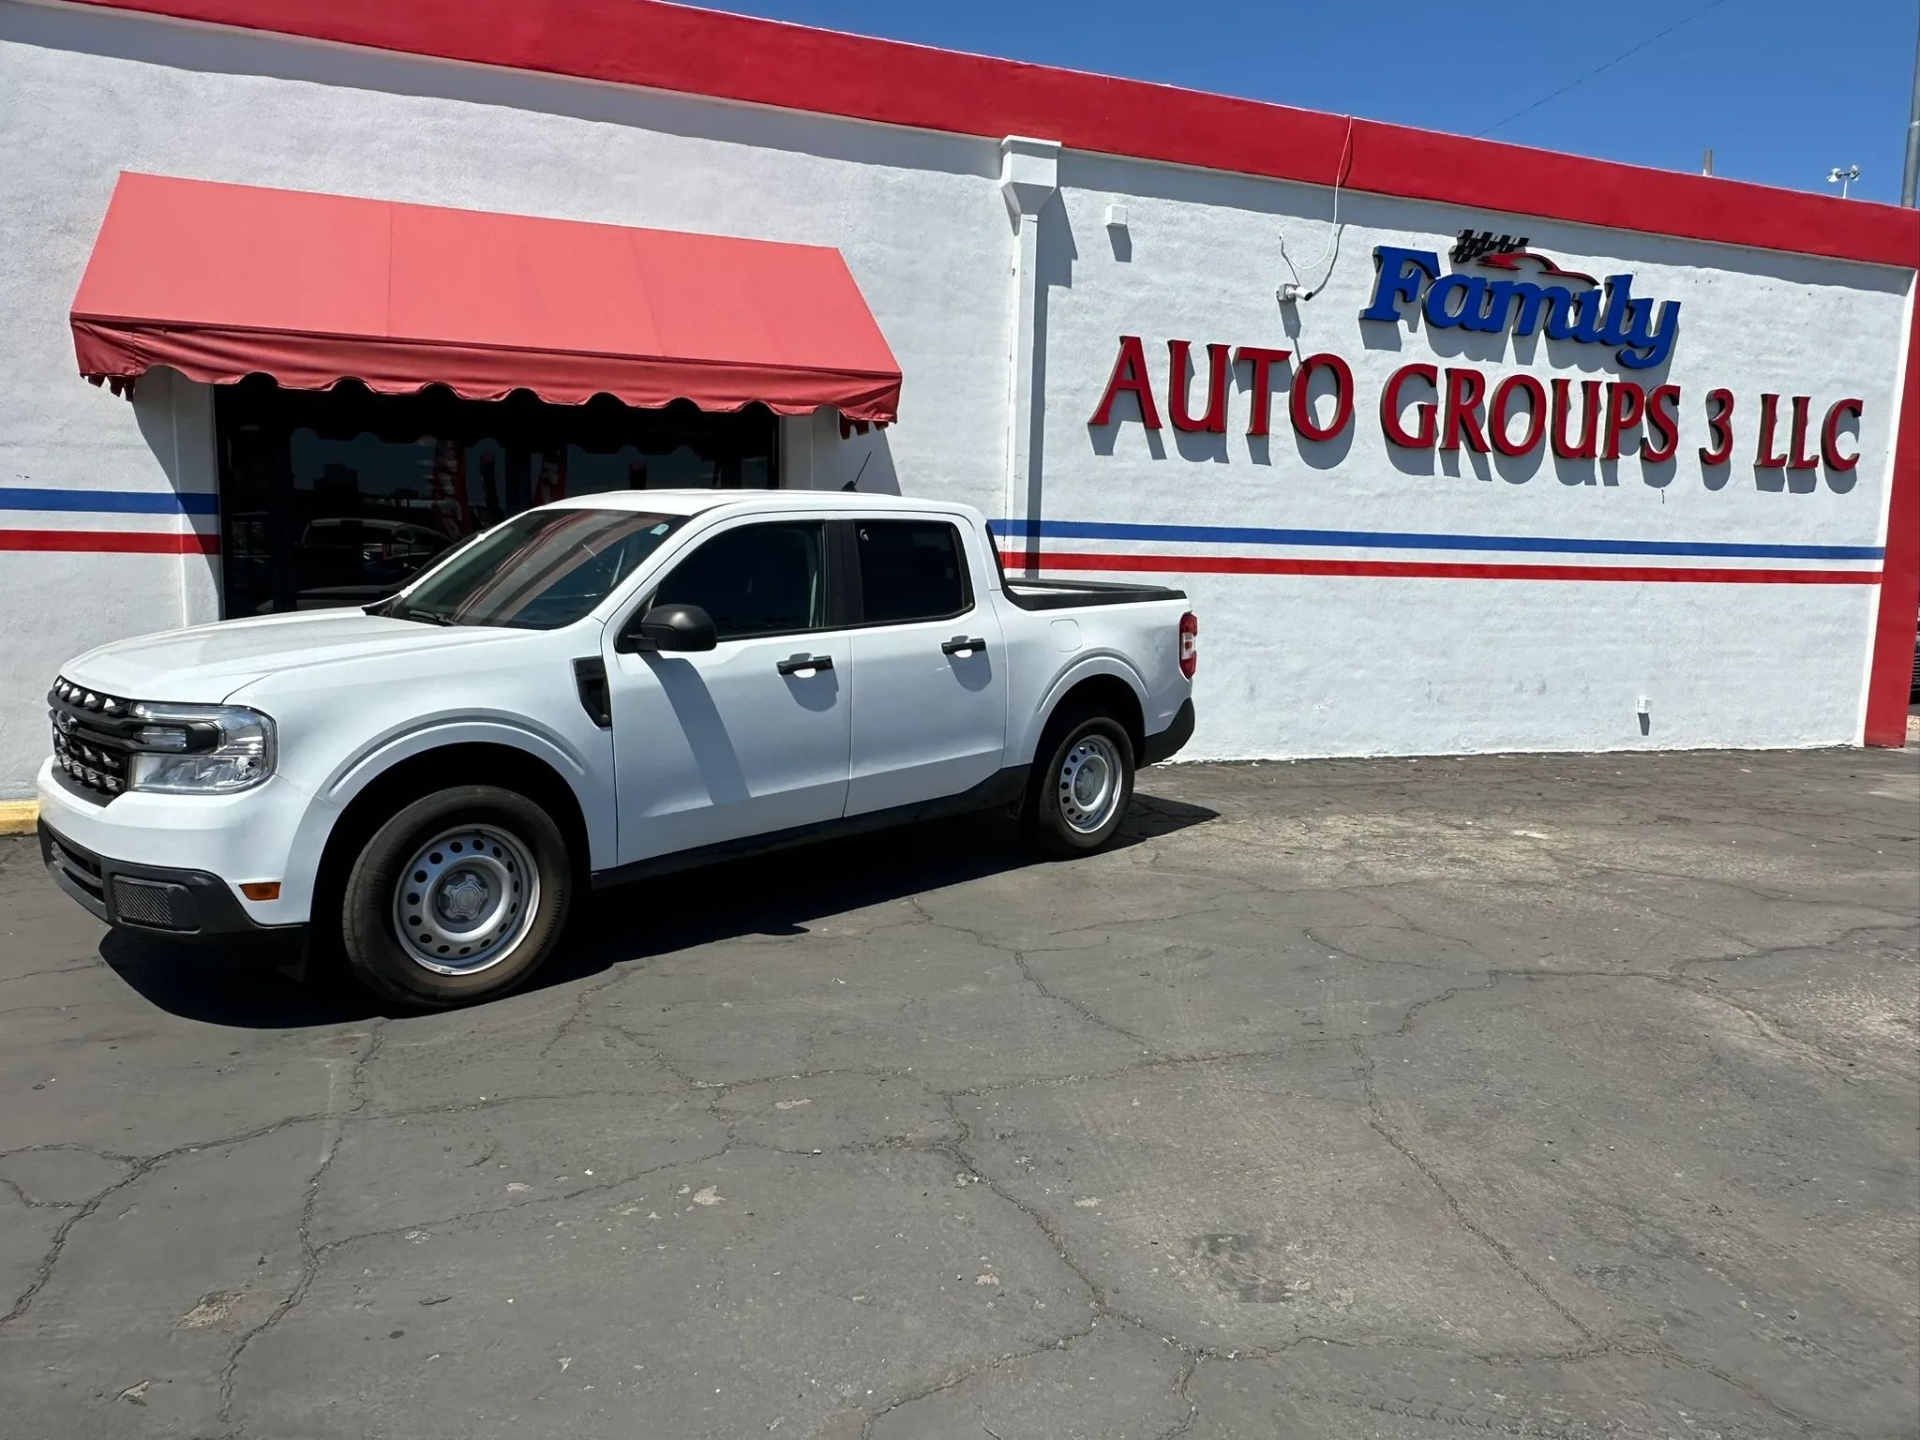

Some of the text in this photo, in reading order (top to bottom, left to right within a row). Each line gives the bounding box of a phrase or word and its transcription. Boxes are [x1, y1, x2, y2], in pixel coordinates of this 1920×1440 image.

[1359, 246, 1681, 369] Family
[1088, 335, 1863, 471] AUTO GROUPS 3 LLC
